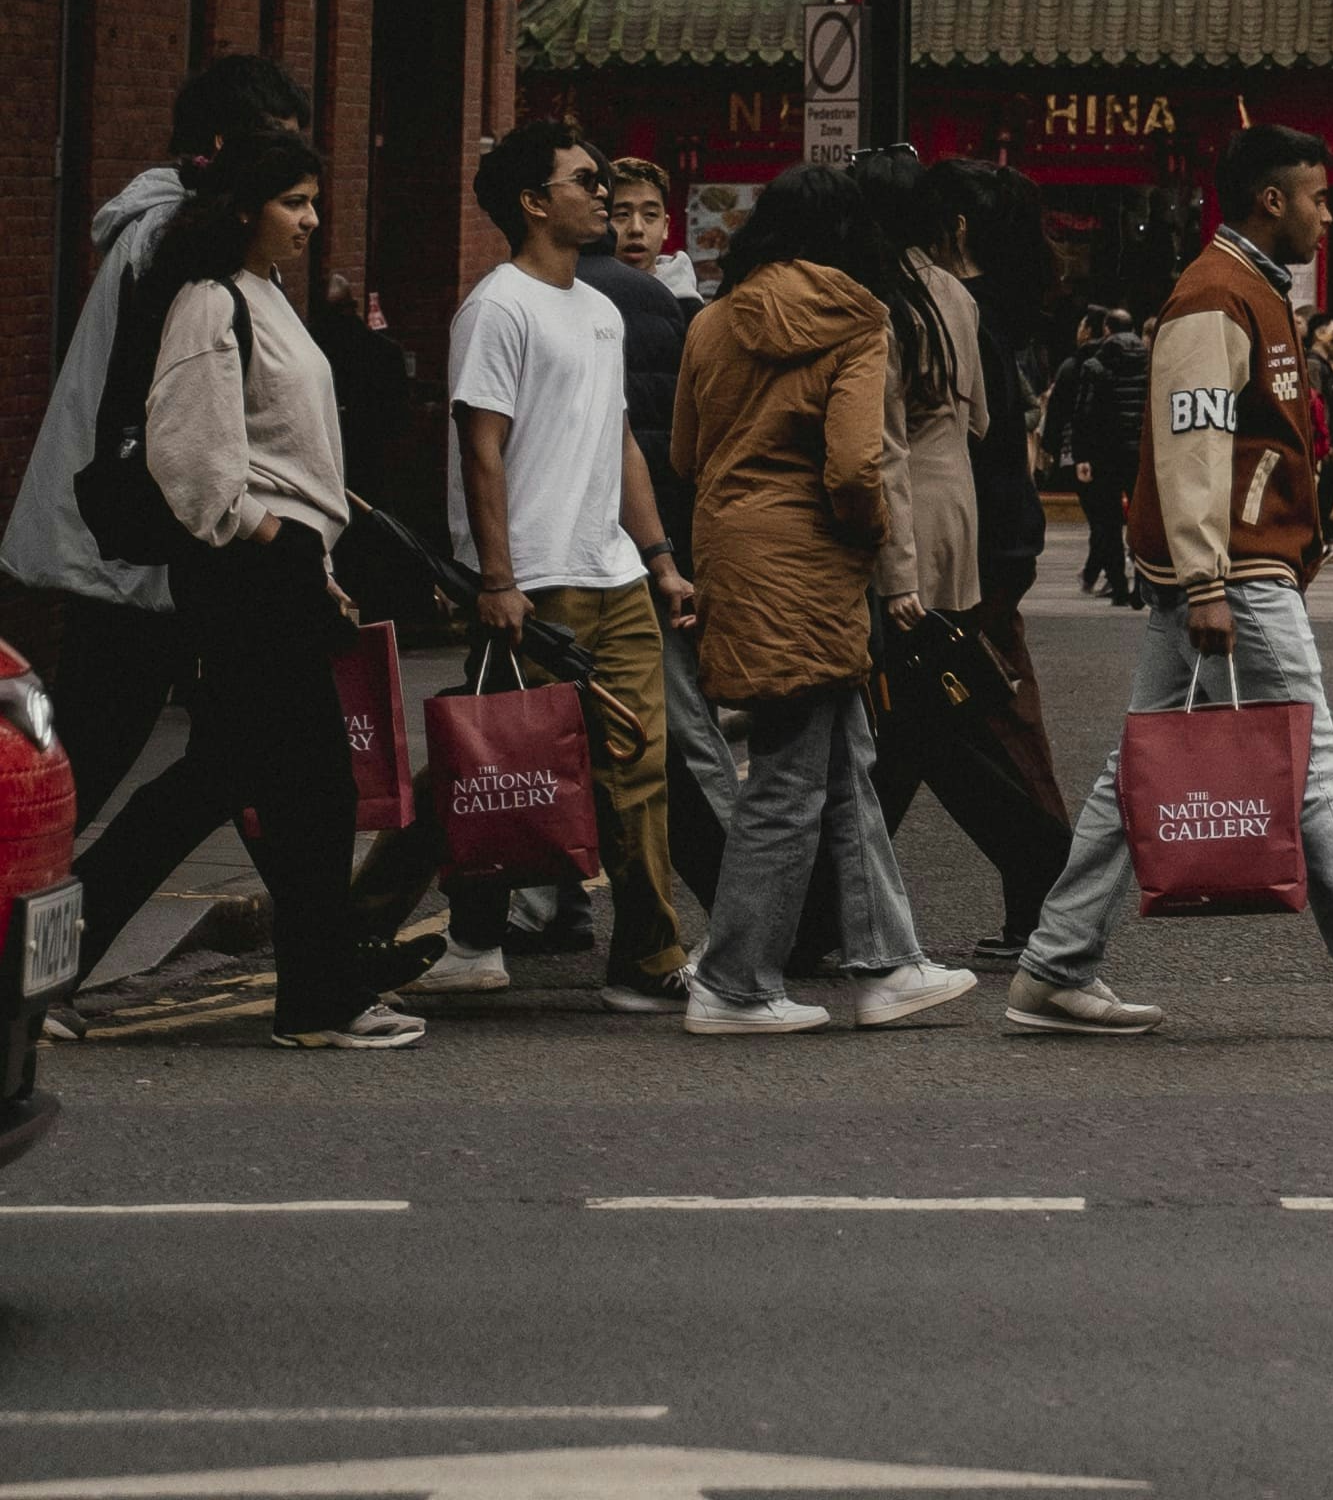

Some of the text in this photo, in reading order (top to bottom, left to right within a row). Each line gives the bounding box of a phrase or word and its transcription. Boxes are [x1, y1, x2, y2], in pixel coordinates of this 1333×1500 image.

[808, 107, 857, 120] Pedestrian
[1044, 94, 1177, 135] HINA
[820, 123, 842, 136] Zone
[811, 144, 853, 163] ENDS
[479, 765, 499, 775] THE
[454, 769, 558, 795] NATIONAL
[453, 786, 559, 814] GALLERY
[1186, 791, 1209, 801] THE
[1158, 799, 1271, 820] NATIONAL
[1158, 818, 1271, 842] GALLERY
